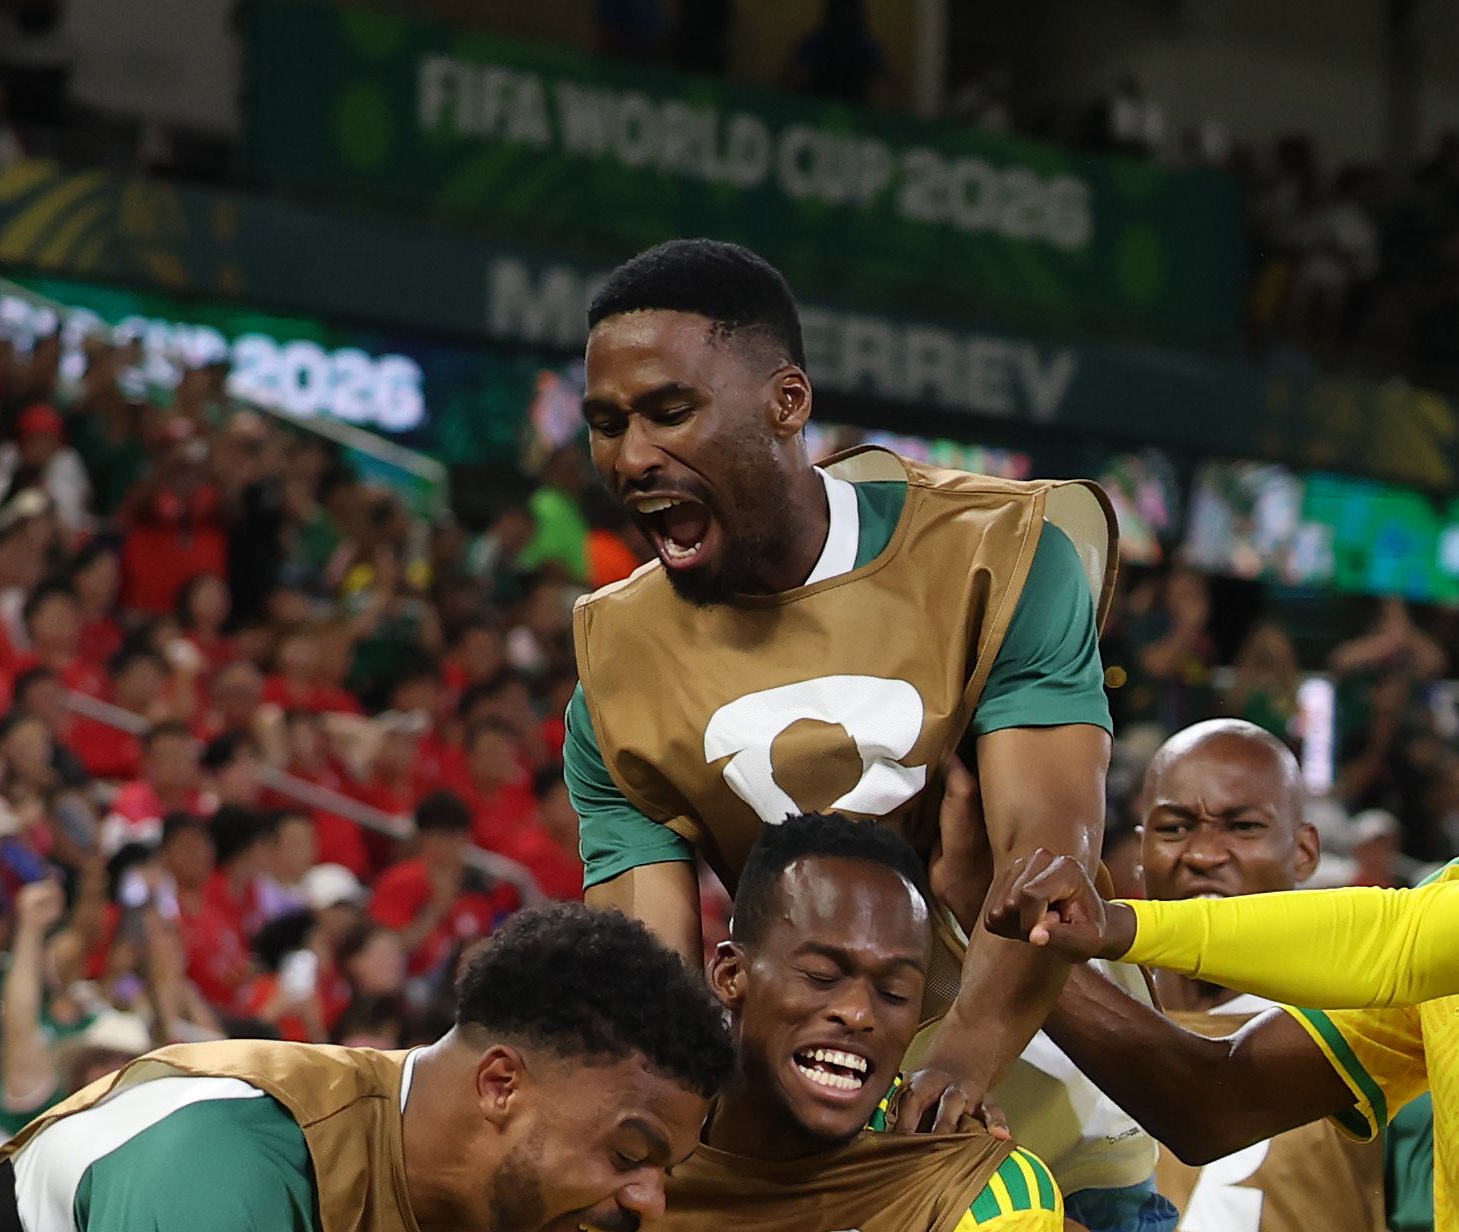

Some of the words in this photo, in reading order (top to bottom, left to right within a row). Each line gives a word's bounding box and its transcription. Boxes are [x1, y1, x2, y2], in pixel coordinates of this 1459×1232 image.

[417, 54, 551, 148] FIFA
[555, 82, 771, 189] WORLD
[778, 121, 893, 208] CUP
[896, 146, 1094, 251] 2026
[226, 332, 425, 432] 2026
